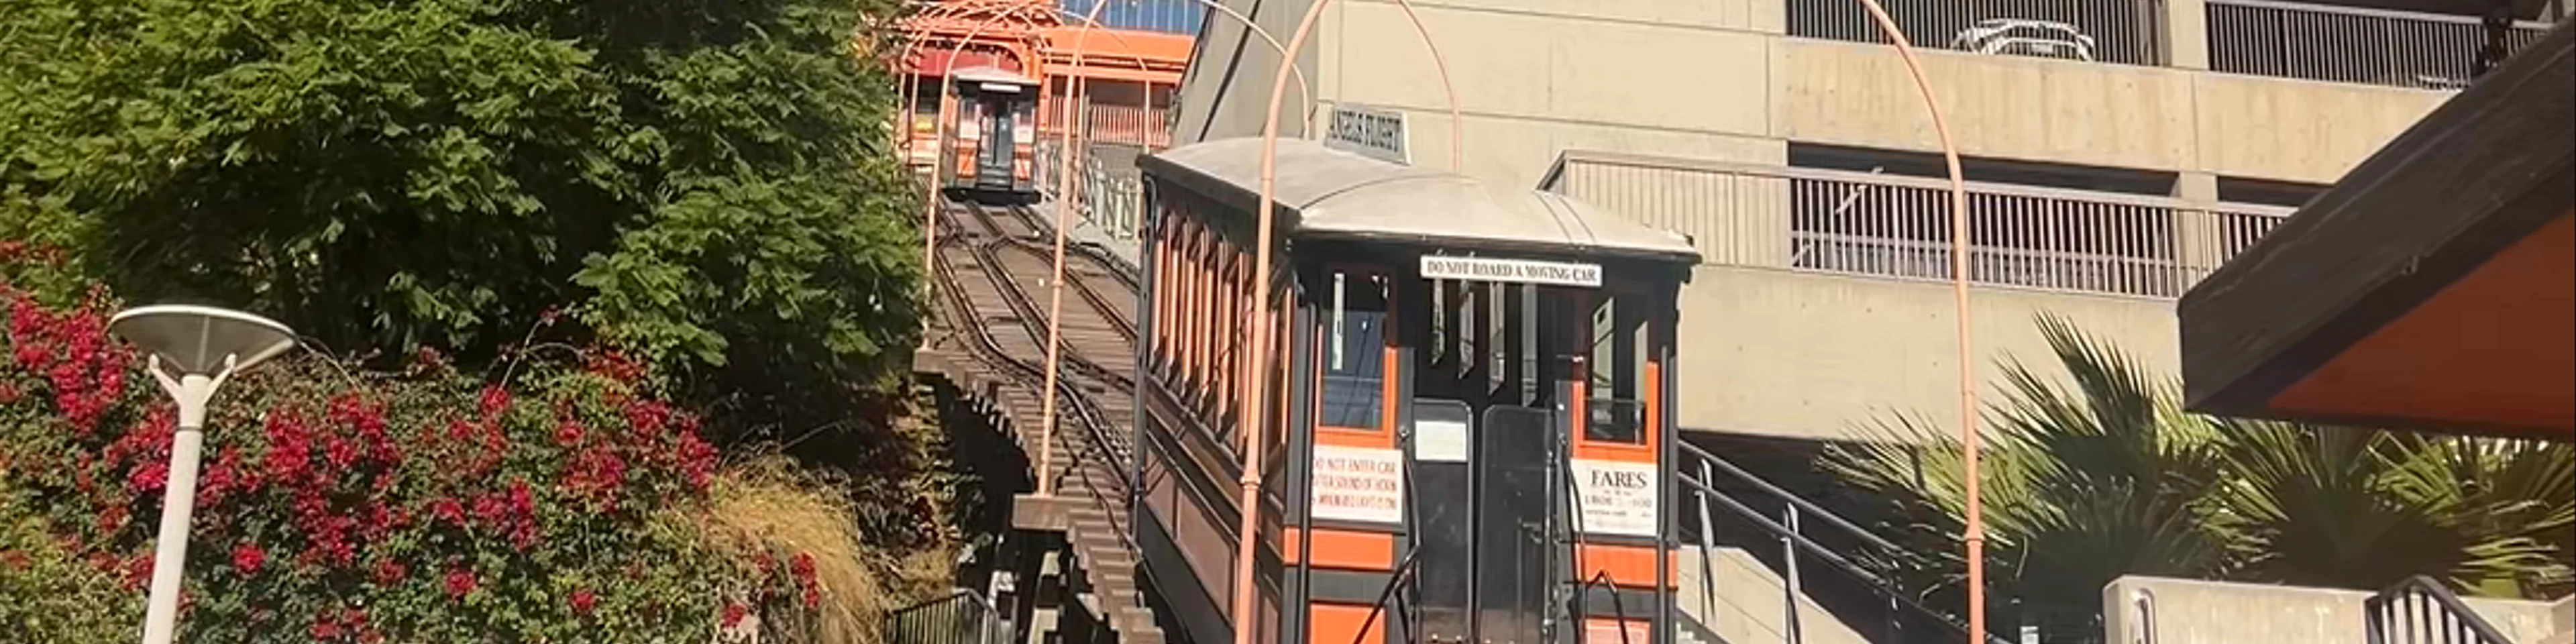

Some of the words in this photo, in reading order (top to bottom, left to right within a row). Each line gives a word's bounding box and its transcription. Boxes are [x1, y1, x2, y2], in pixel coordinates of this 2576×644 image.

[1428, 260, 1444, 274] DO
[1446, 261, 1469, 275] NOT
[1472, 262, 1512, 277] BOARD
[1514, 264, 1524, 278] A
[1525, 264, 1570, 280] MOVING
[1572, 268, 1597, 282] CAR
[1328, 458, 1346, 471] NOT
[1348, 458, 1375, 472] ENTER
[1591, 468, 1648, 489] FARES
